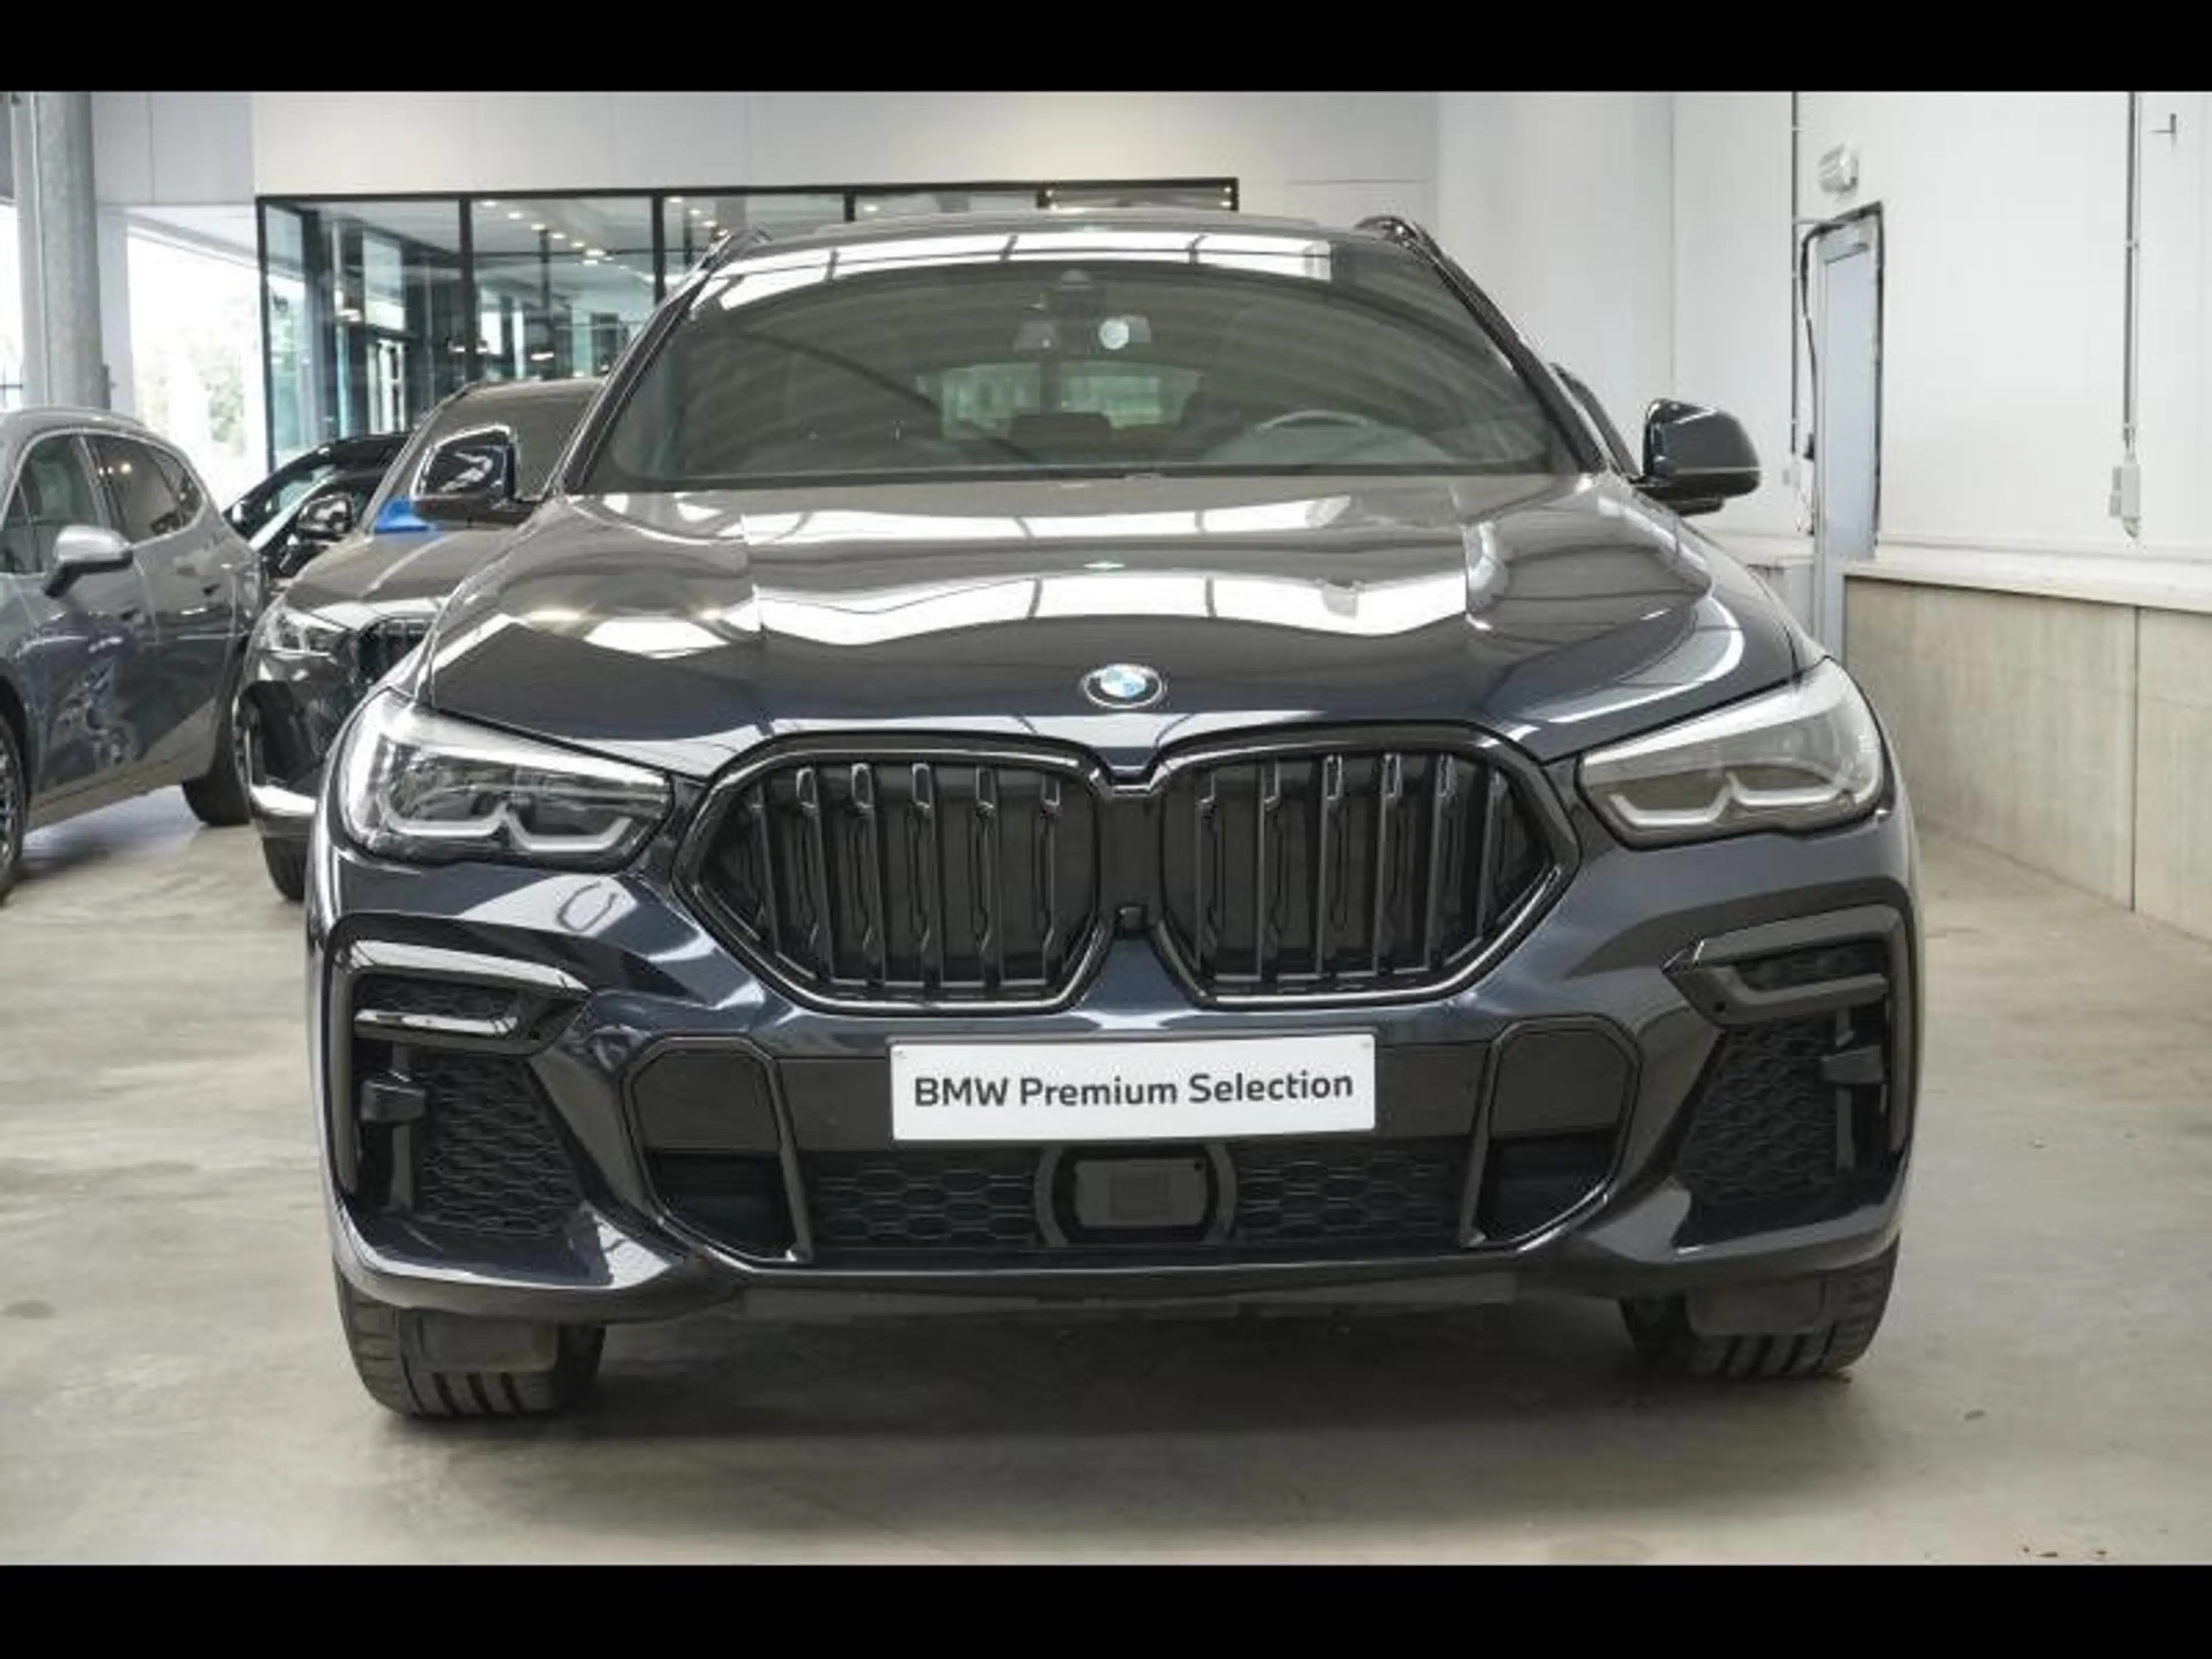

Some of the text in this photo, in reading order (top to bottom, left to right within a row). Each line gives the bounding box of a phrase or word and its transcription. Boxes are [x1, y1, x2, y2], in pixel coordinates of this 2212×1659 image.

[914, 1070, 1353, 1107] BMW Premium Selection
